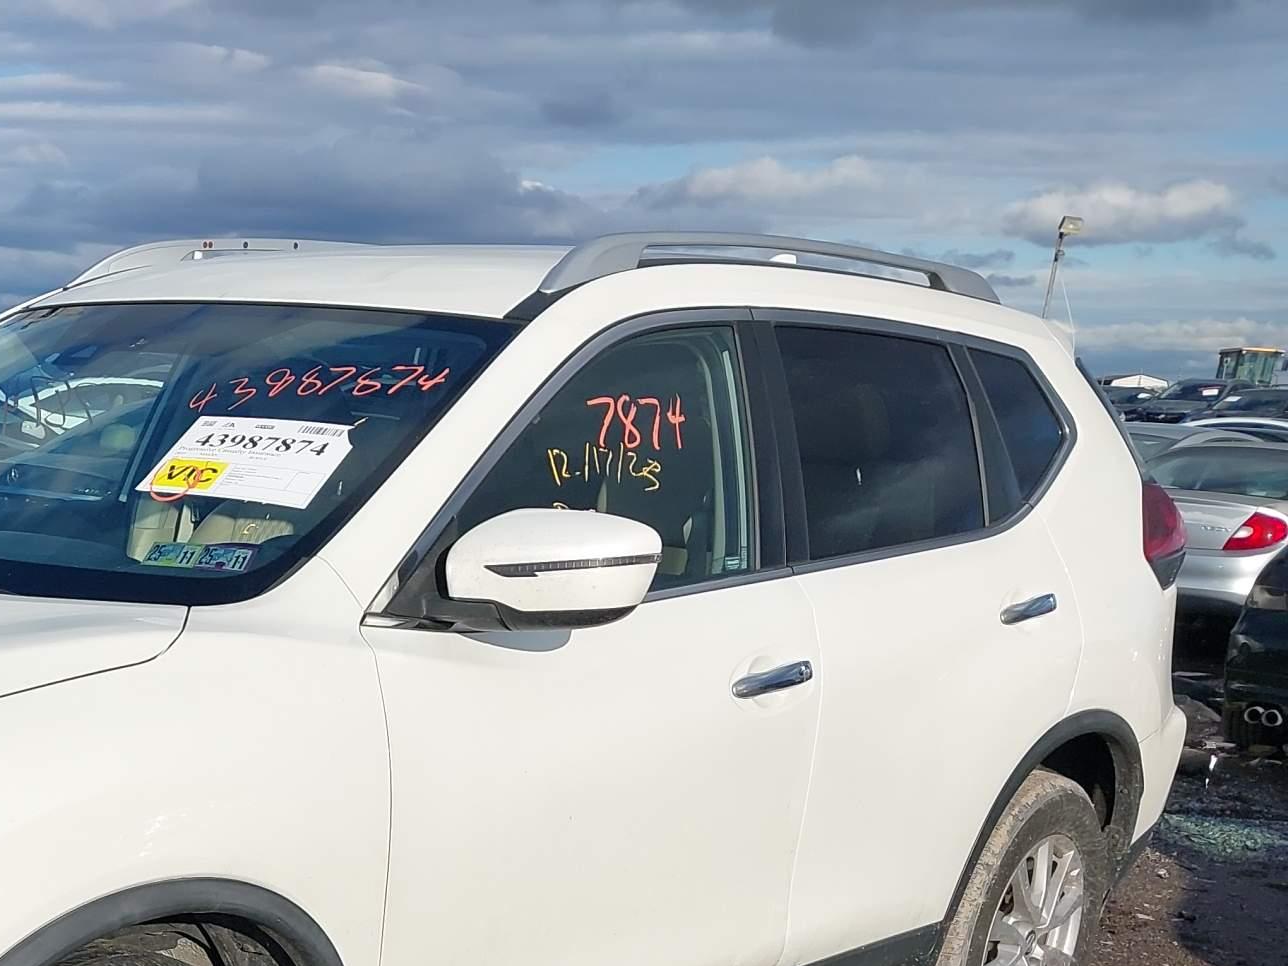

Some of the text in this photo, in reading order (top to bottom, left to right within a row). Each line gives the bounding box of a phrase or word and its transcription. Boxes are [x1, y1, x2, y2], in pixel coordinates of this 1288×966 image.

[586, 393, 686, 451] 7874
[196, 432, 330, 457] 43987874
[147, 544, 197, 565] 25 11
[198, 547, 249, 570] 25 11
